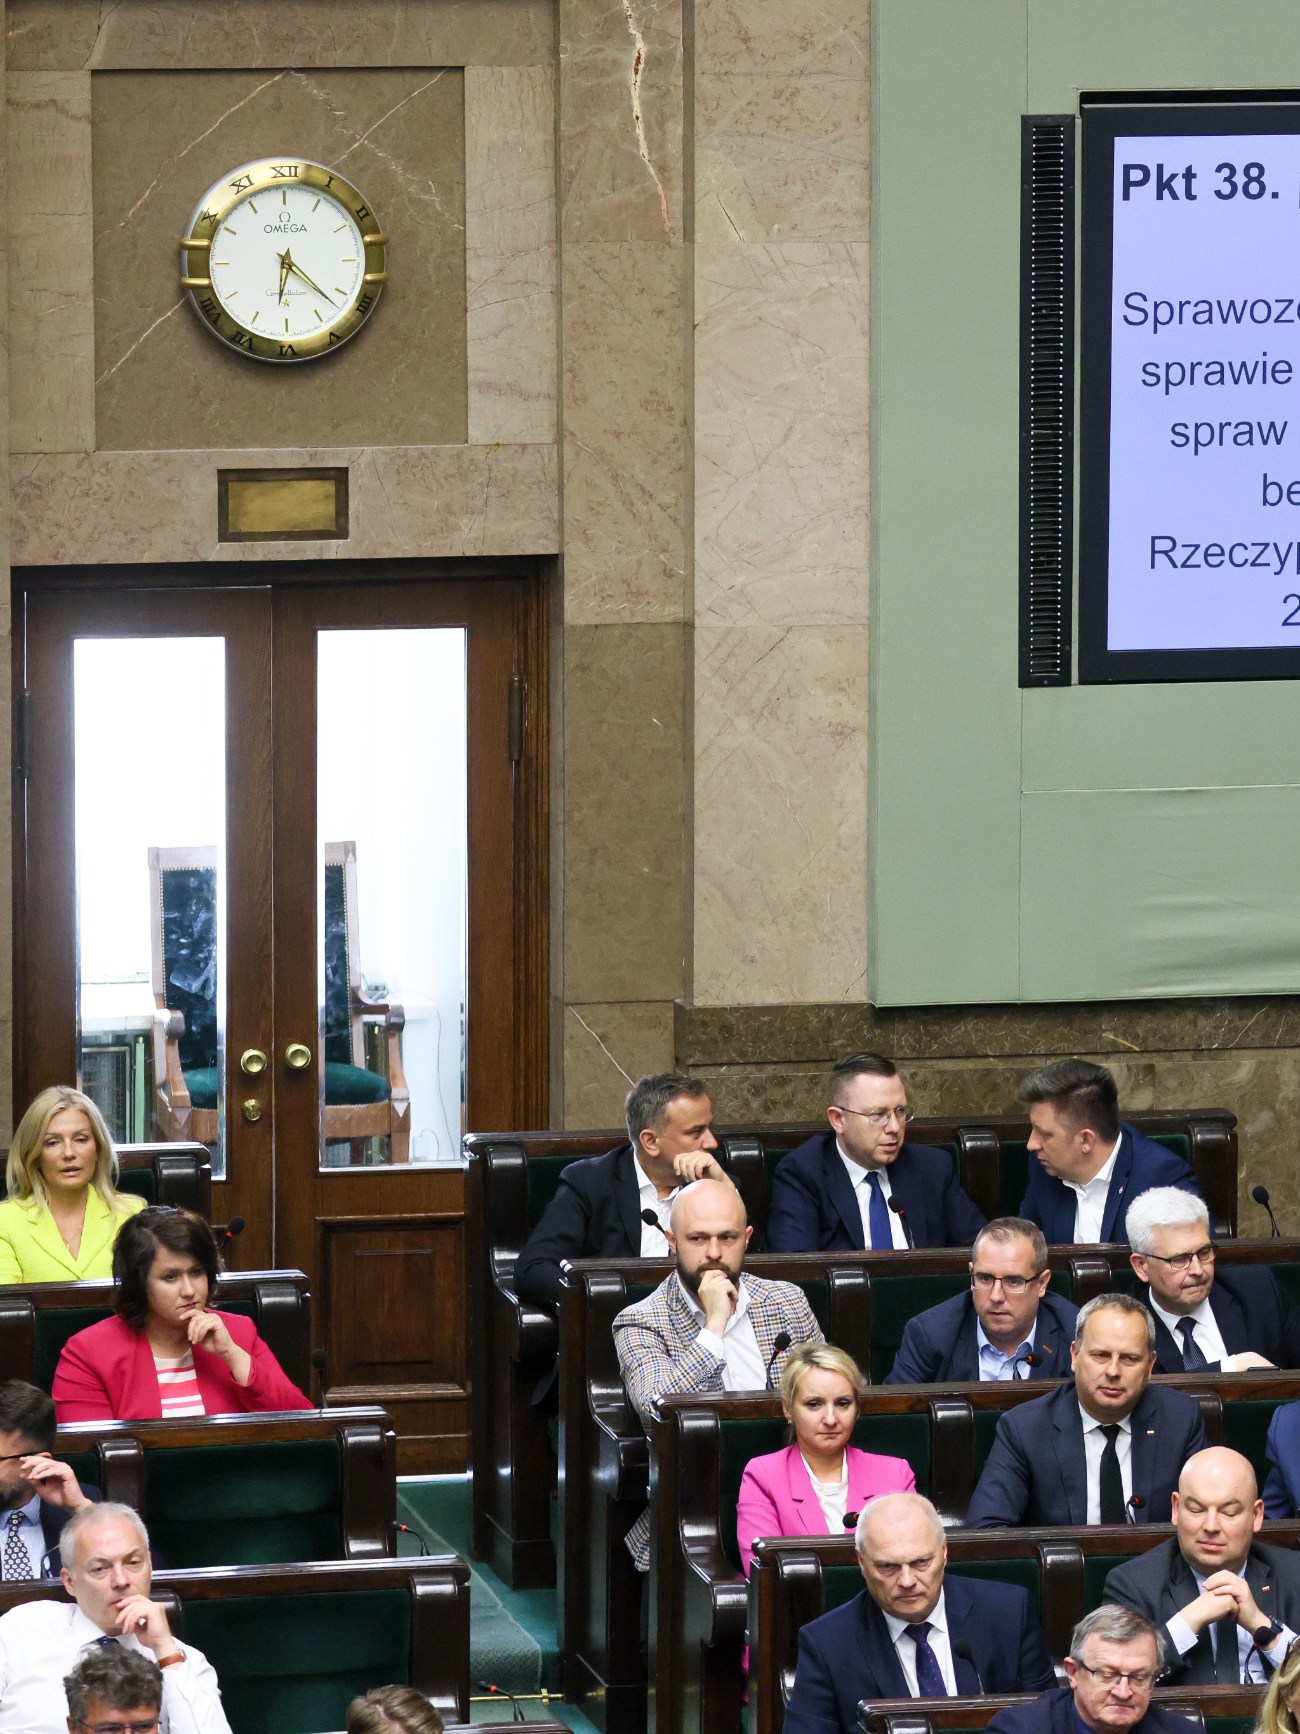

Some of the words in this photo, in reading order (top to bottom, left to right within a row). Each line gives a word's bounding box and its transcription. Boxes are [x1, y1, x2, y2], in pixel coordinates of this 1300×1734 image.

[269, 165, 299, 179] XII
[229, 175, 255, 196] XI
[1121, 162, 1198, 202] Pkt
[1213, 161, 1280, 201] 38.
[200, 207, 219, 226] X
[355, 205, 370, 222] II
[263, 224, 308, 234] OMEGA
[265, 288, 307, 297] Conellation
[328, 331, 343, 346] V
[278, 344, 298, 356] VI
[1140, 350, 1294, 396] sprawie
[1170, 420, 1289, 457] spraw
